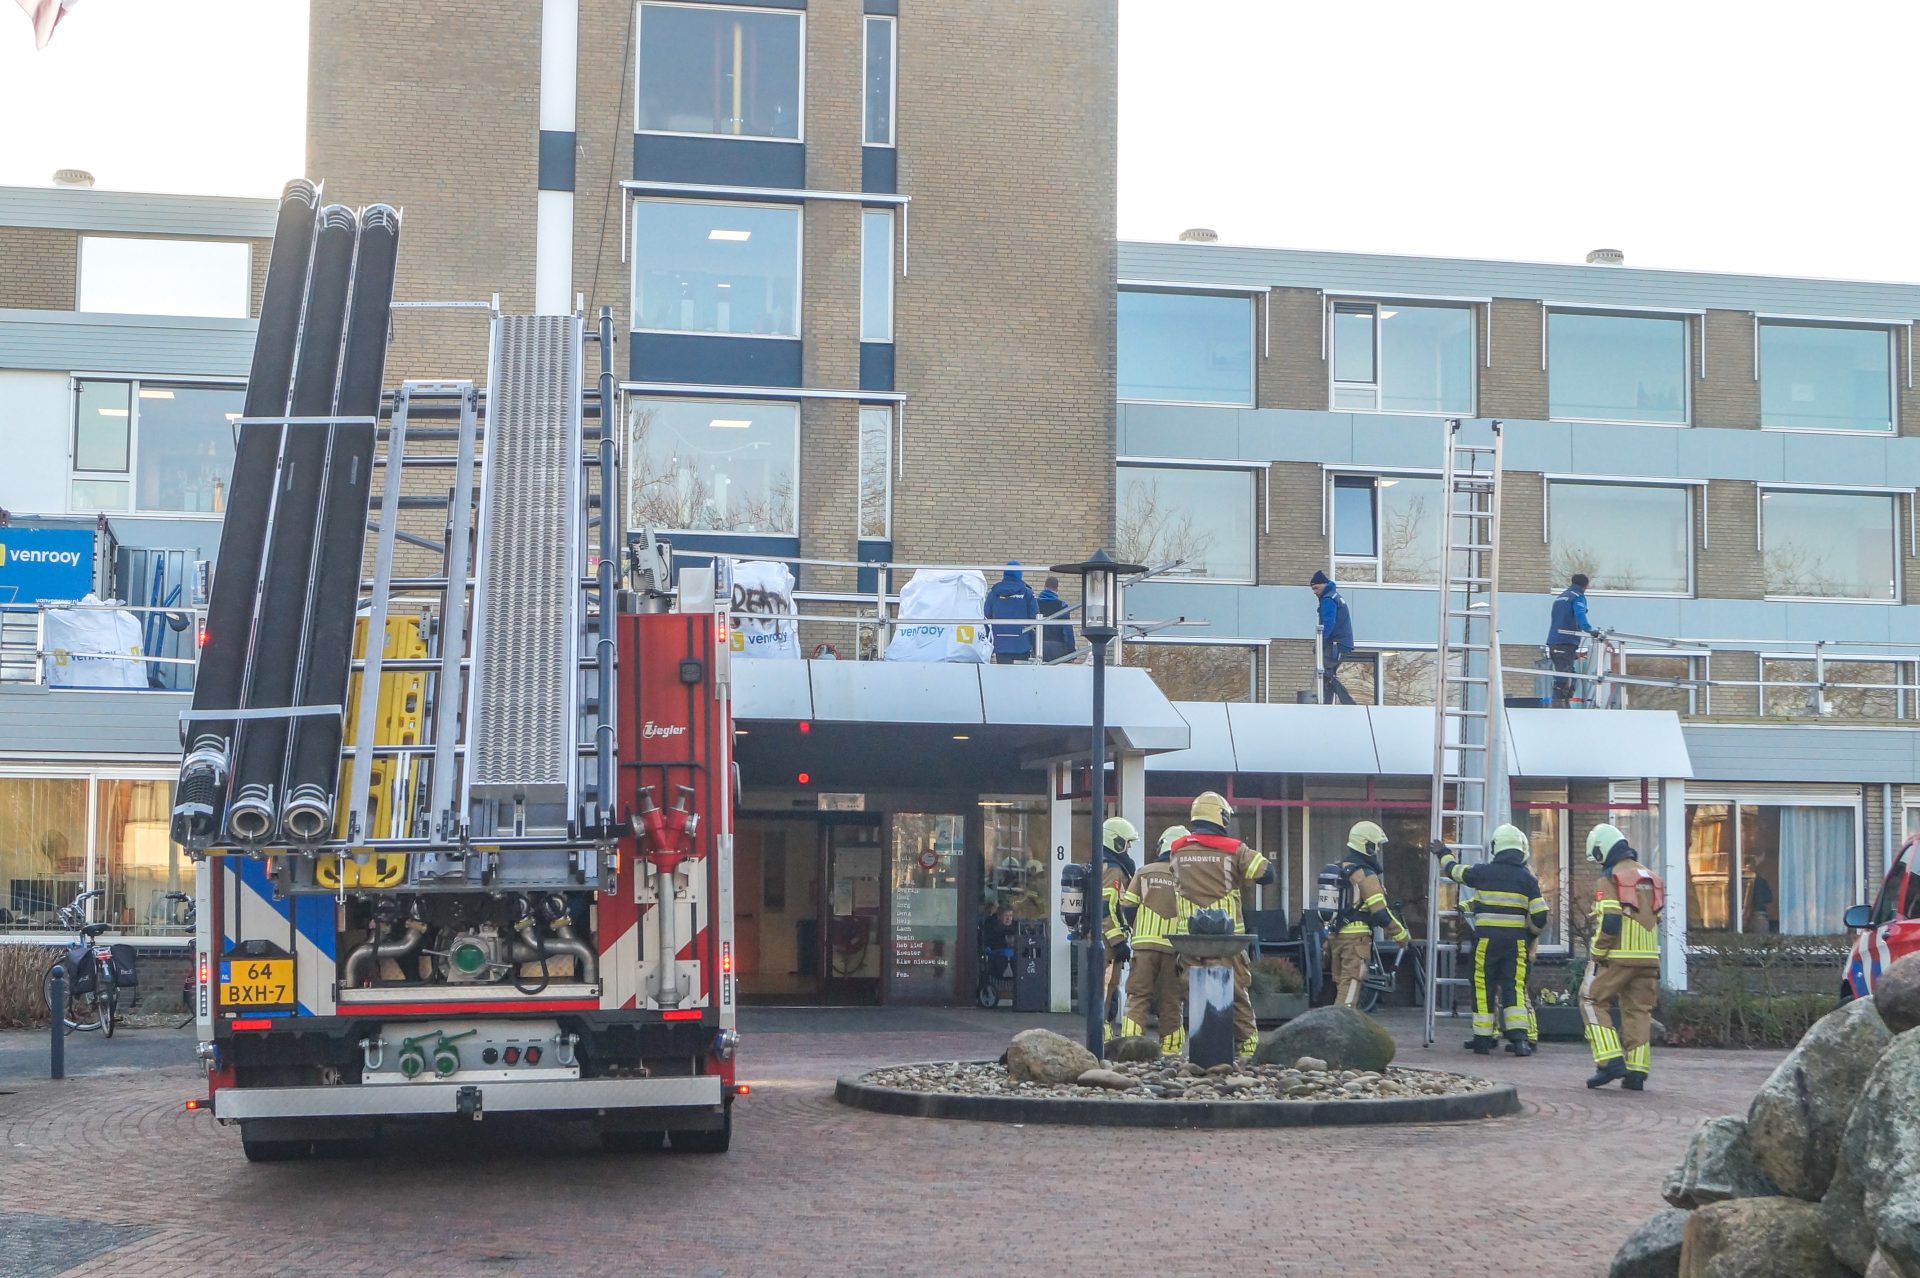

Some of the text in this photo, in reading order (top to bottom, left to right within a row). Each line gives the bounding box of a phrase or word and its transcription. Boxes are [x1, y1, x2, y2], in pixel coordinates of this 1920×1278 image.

[10, 550, 80, 567] venrooy
[748, 632, 787, 645] venrooy
[901, 626, 945, 638] venrooy
[1057, 846, 1065, 861] 8
[248, 963, 272, 980] 64
[229, 985, 286, 1002] BXH-7
